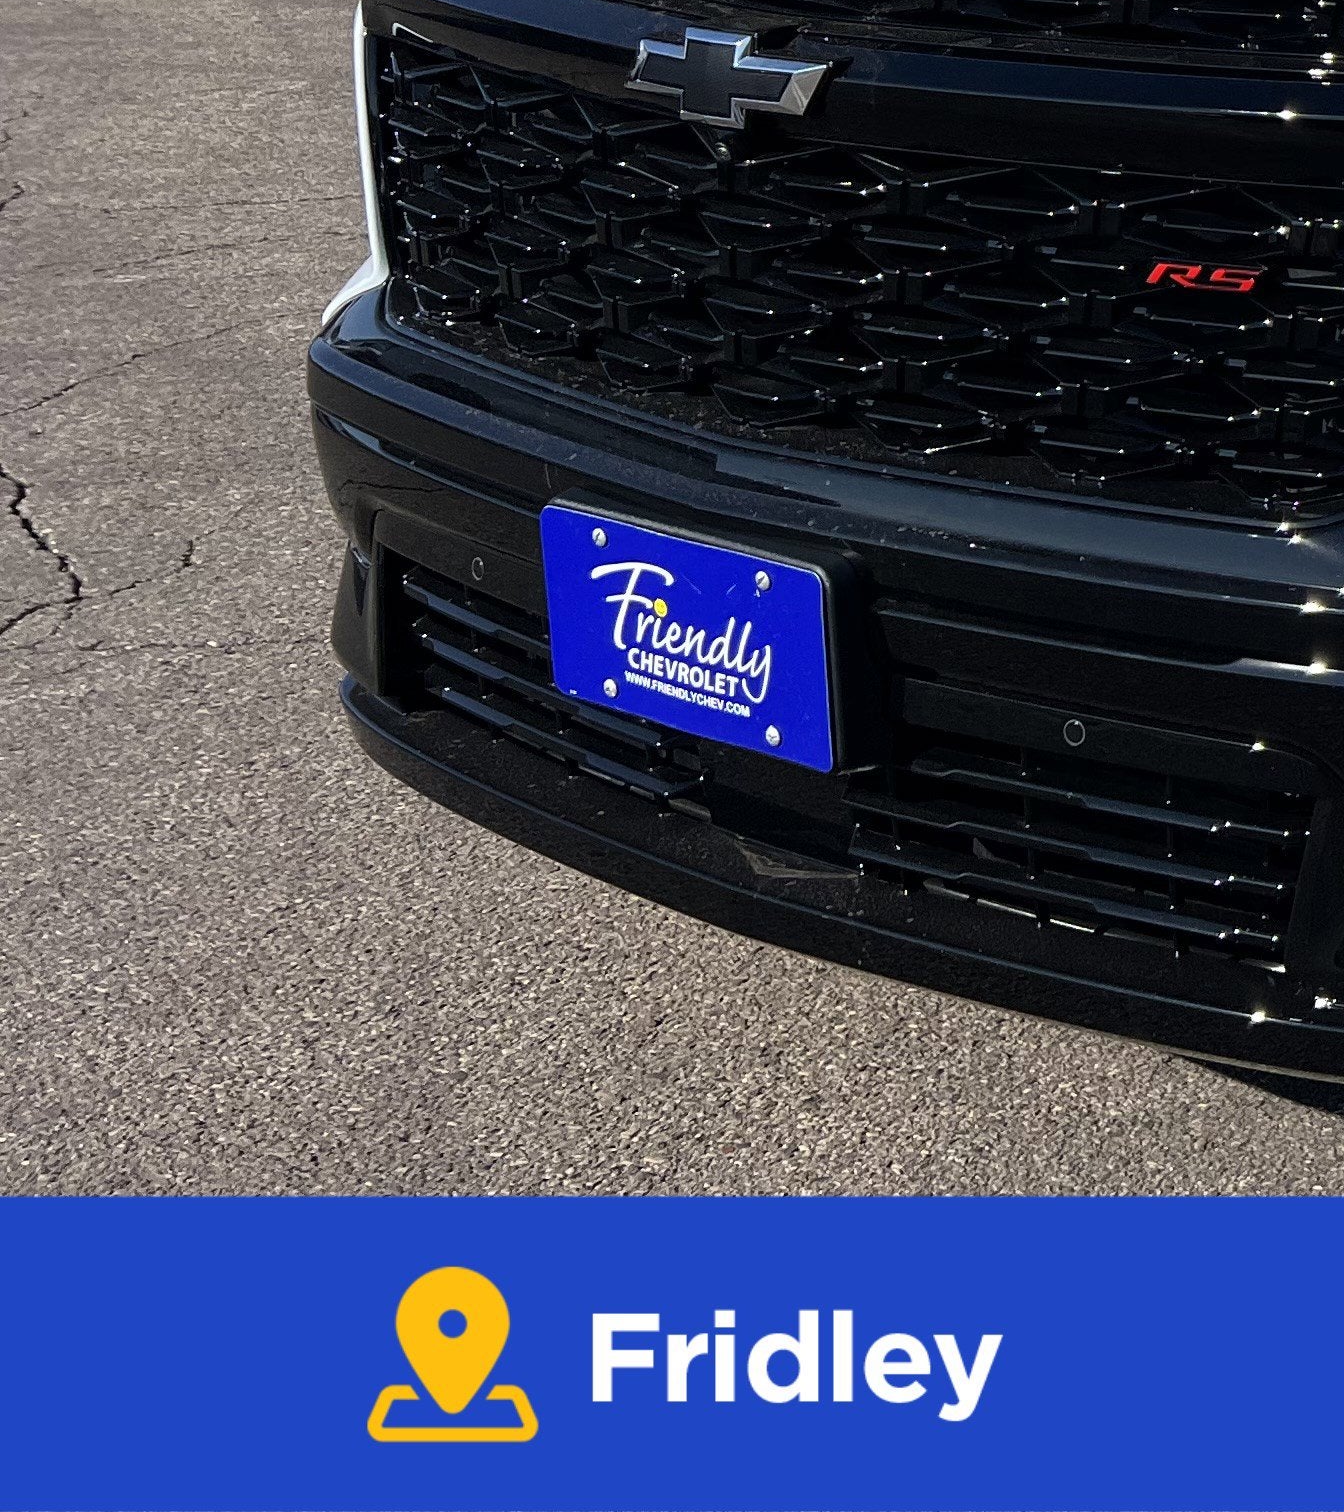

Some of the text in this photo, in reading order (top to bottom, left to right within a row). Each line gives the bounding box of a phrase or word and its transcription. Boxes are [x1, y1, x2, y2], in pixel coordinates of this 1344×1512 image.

[1146, 263, 1260, 293] RS
[590, 561, 771, 704] Friendly
[624, 670, 751, 718] WWW.FRIENDLYCHEV.COM
[627, 647, 739, 698] CHEVROLET
